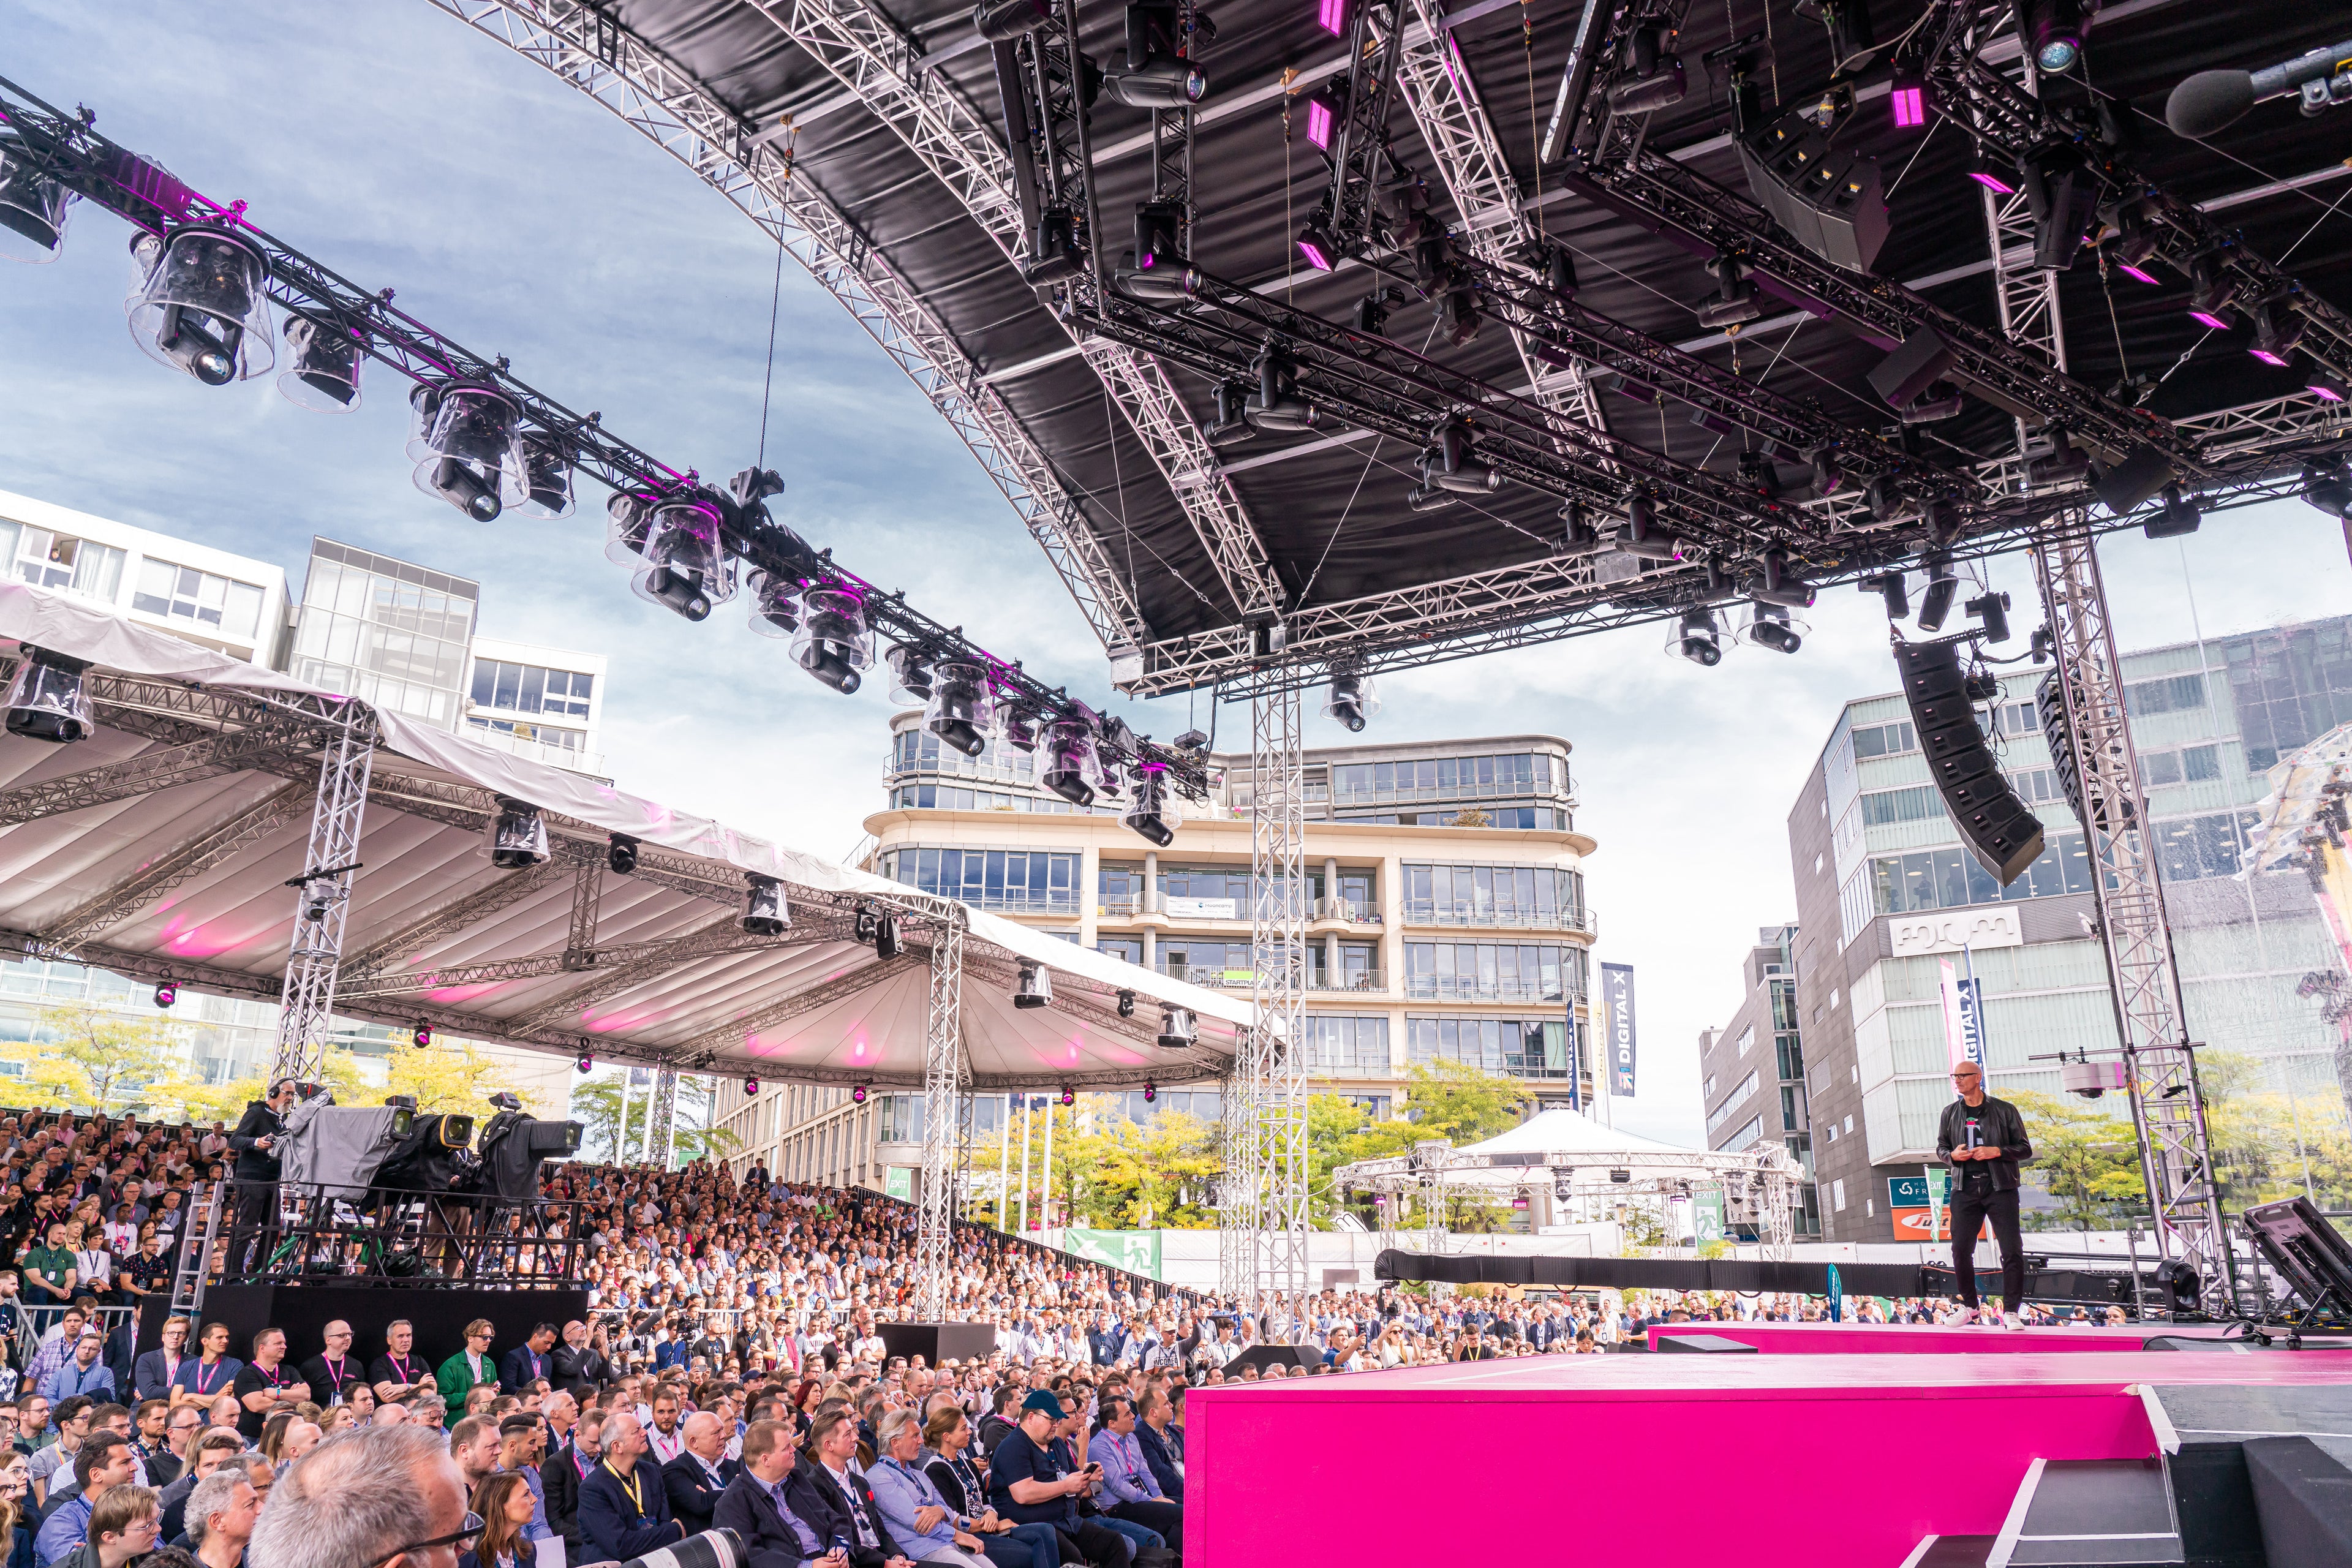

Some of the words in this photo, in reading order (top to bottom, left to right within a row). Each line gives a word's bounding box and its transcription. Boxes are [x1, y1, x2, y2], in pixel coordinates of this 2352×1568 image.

[1613, 971, 1626, 986] X
[1958, 987, 1972, 1000] X
[1615, 989, 1630, 1063] DIGITAL
[1961, 1004, 1978, 1062] IGITAL
[890, 1180, 907, 1188] EXIT
[1911, 1217, 1949, 1226] Jut
